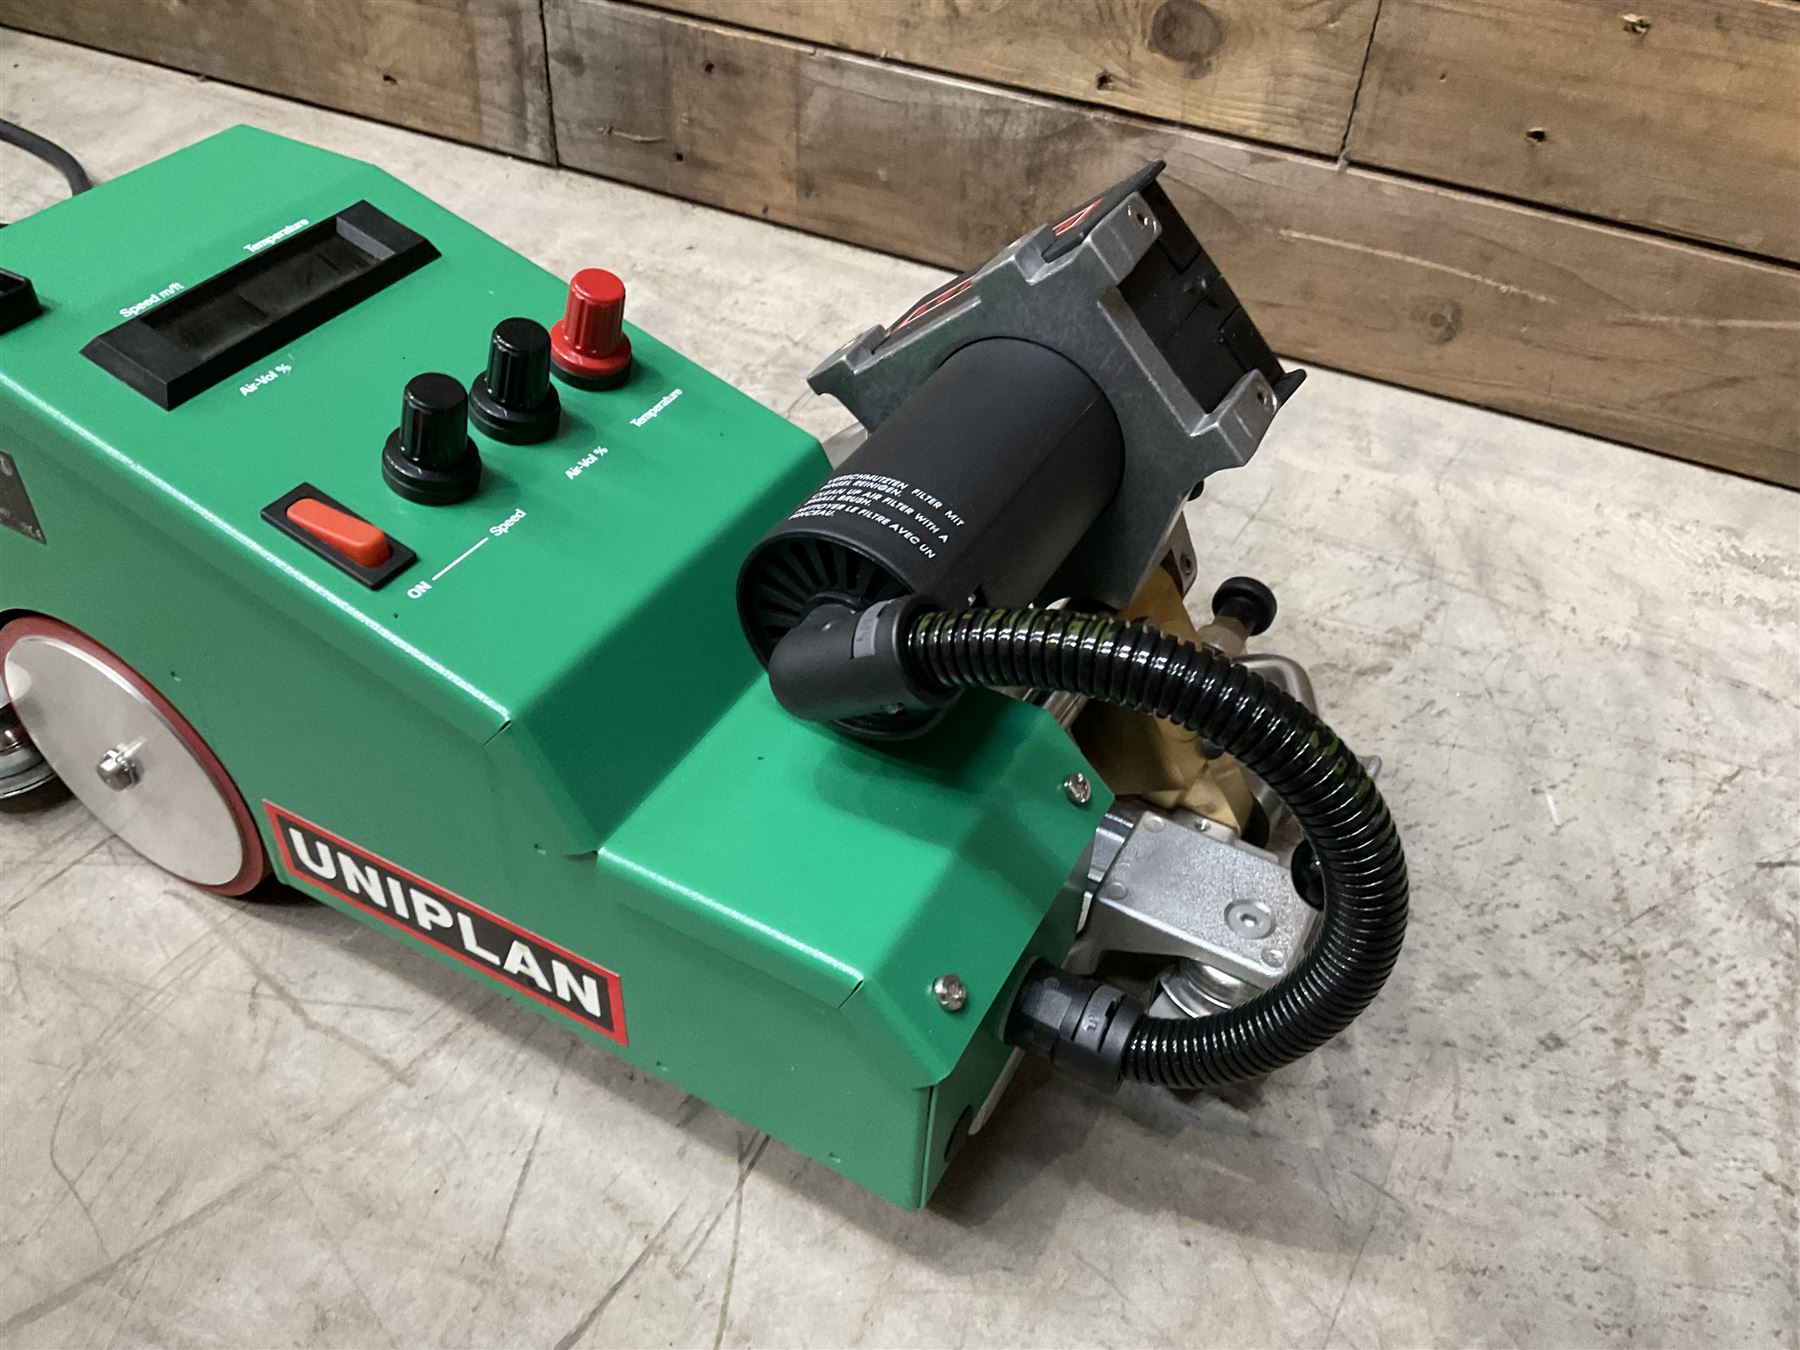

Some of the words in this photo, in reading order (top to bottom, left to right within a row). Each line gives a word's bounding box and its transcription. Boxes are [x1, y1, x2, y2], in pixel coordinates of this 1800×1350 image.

[243, 218, 309, 253] Temperature
[119, 294, 161, 317] Speed
[239, 370, 279, 397] Air-Vol
[275, 363, 292, 374] %
[629, 388, 683, 428] Temperature
[565, 452, 600, 480] Air-Vol
[594, 446, 608, 457] %
[489, 508, 527, 537] Speed
[846, 488, 863, 496] UP
[861, 491, 883, 501] AIR
[881, 497, 915, 516] FILTER
[914, 512, 939, 534] WITH
[938, 534, 949, 543] A
[911, 488, 943, 509] FILTER
[944, 510, 965, 527] MIT
[844, 505, 860, 513] LE
[857, 508, 892, 526] FILTRE
[888, 523, 920, 545] AVEC
[918, 543, 936, 559] UN
[407, 580, 432, 600] ON
[288, 827, 602, 1017] UNIPLAN
